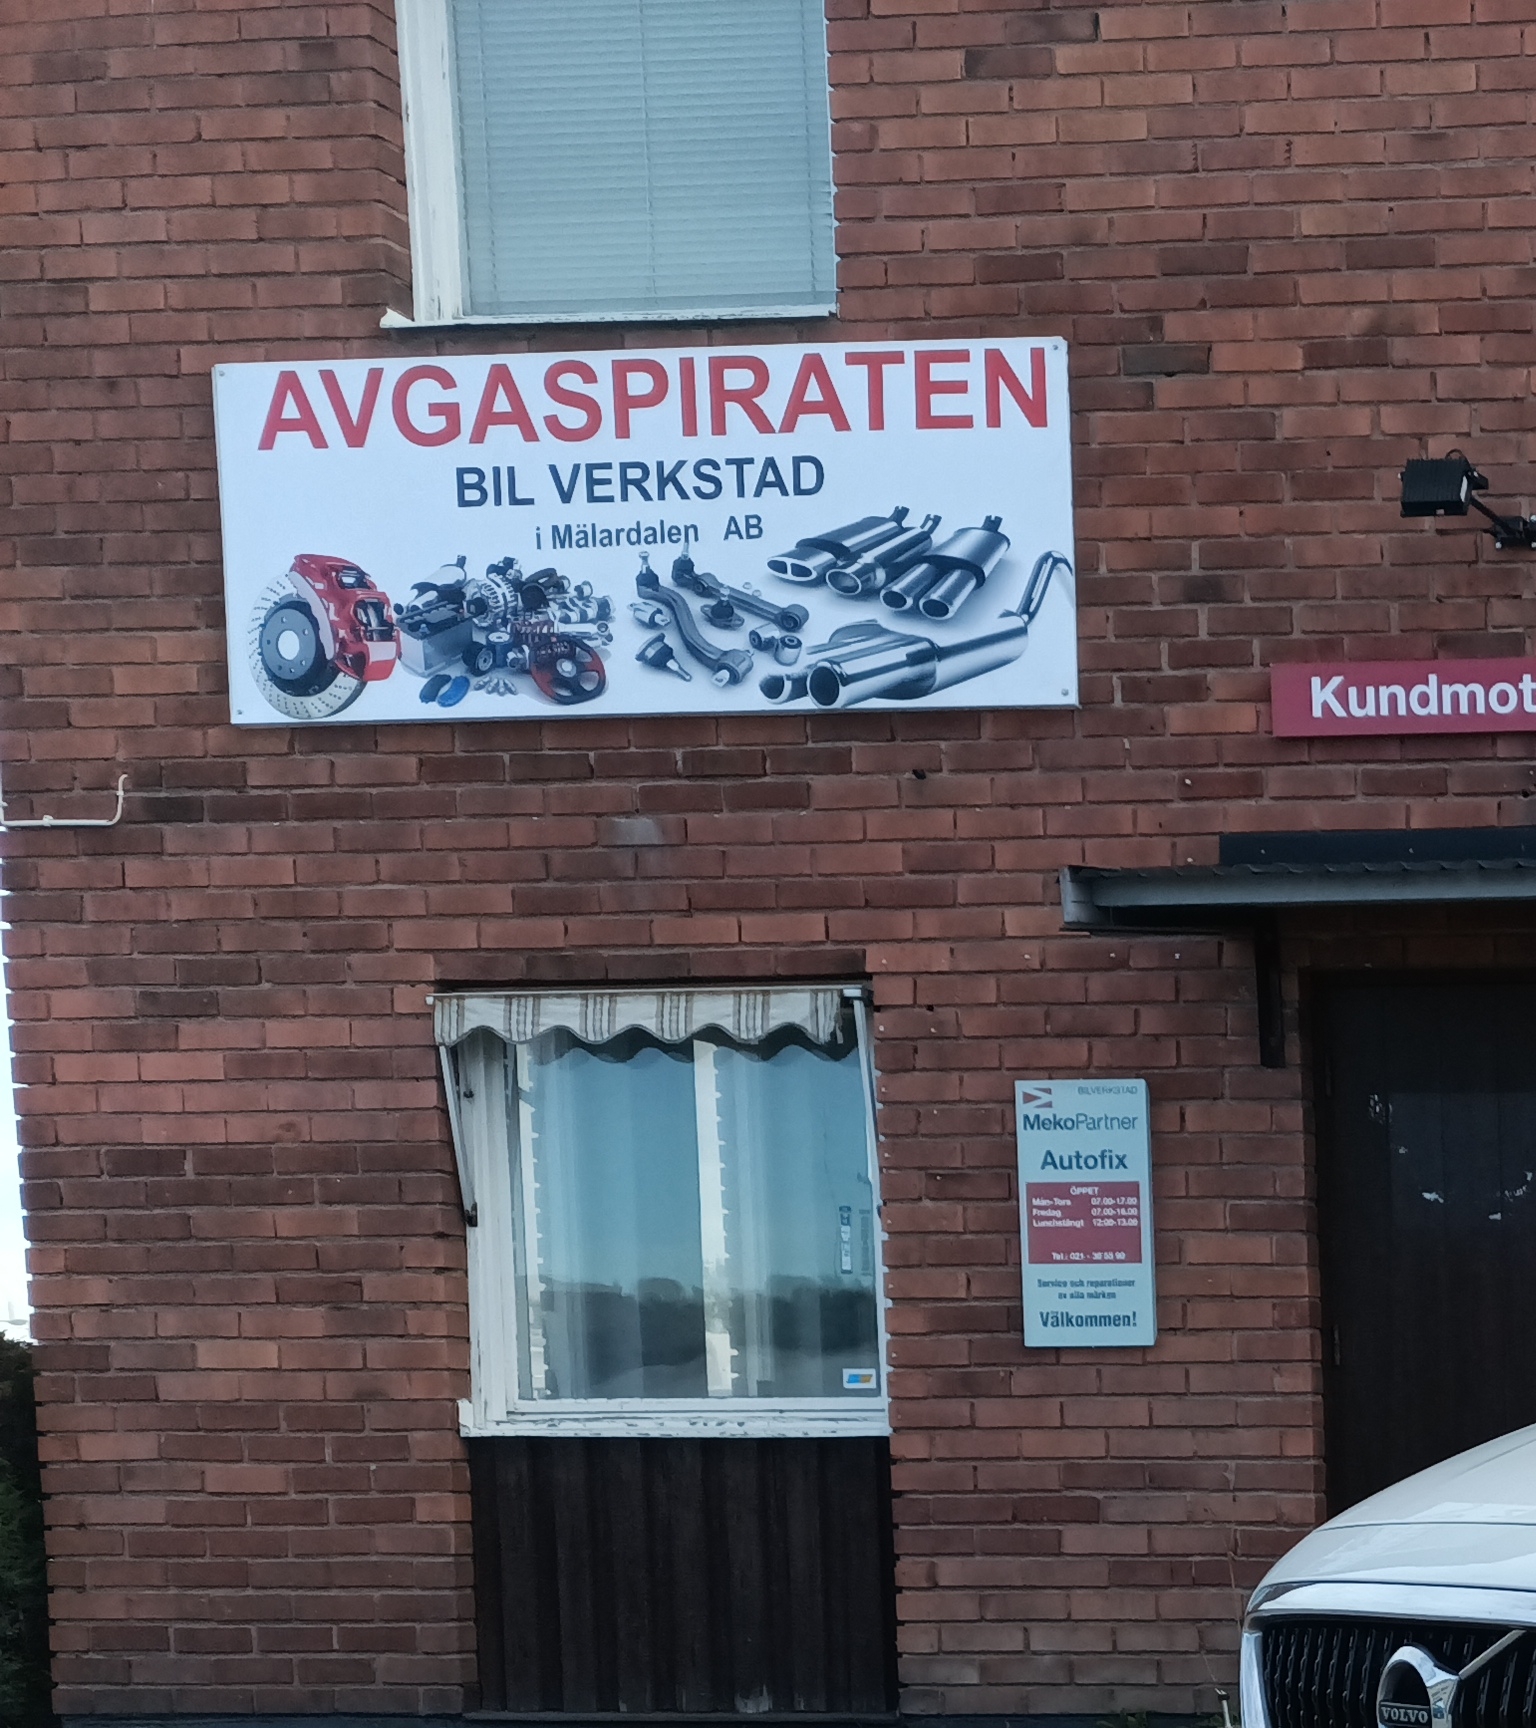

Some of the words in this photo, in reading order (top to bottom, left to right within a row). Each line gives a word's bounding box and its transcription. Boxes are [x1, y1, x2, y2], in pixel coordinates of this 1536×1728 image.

[257, 346, 1050, 452] AVGASPIRATEN
[454, 464, 536, 508] BIL
[549, 454, 825, 505] VERKSTAD
[535, 525, 542, 551] i
[551, 517, 700, 551] Mälardalen
[723, 514, 765, 543] AB
[1078, 1086, 1139, 1096] BILVERKSTAD
[1022, 1113, 1139, 1131] MekoPartner
[1041, 1149, 1128, 1170] Autofix
[1040, 1311, 1138, 1328] Välkommen!
[1380, 1706, 1429, 1723] VOLVO
